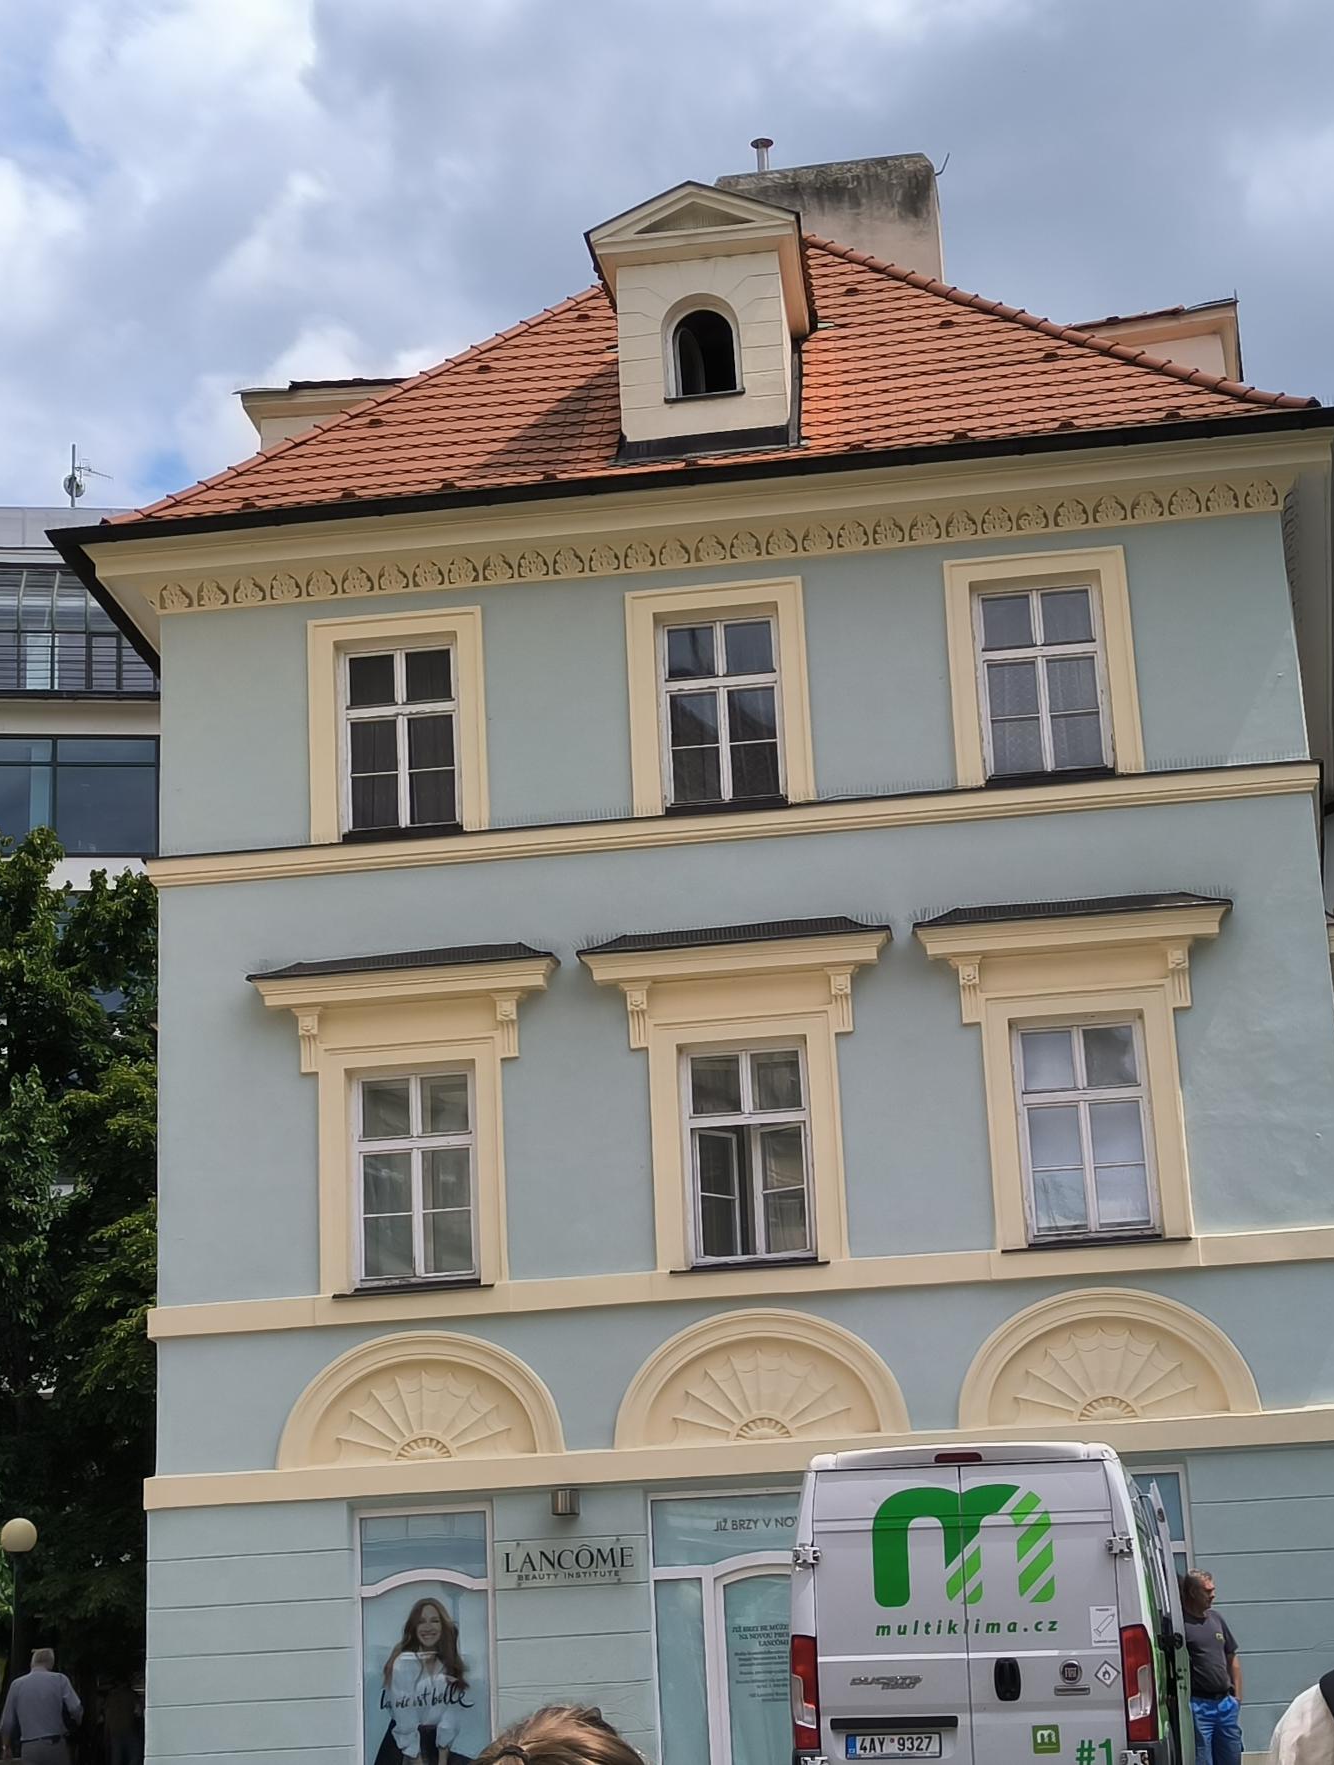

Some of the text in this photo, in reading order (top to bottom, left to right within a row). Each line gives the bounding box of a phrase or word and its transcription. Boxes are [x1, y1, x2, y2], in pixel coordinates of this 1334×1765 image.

[731, 1518, 759, 1531] BRZY
[762, 1518, 771, 1528] V
[504, 1544, 634, 1573] LANCÔME
[517, 1569, 620, 1582] BEAUTY INSTITUTE
[875, 1619, 1059, 1636] multiklima.cz
[859, 1736, 932, 1753] 4AY 9327
